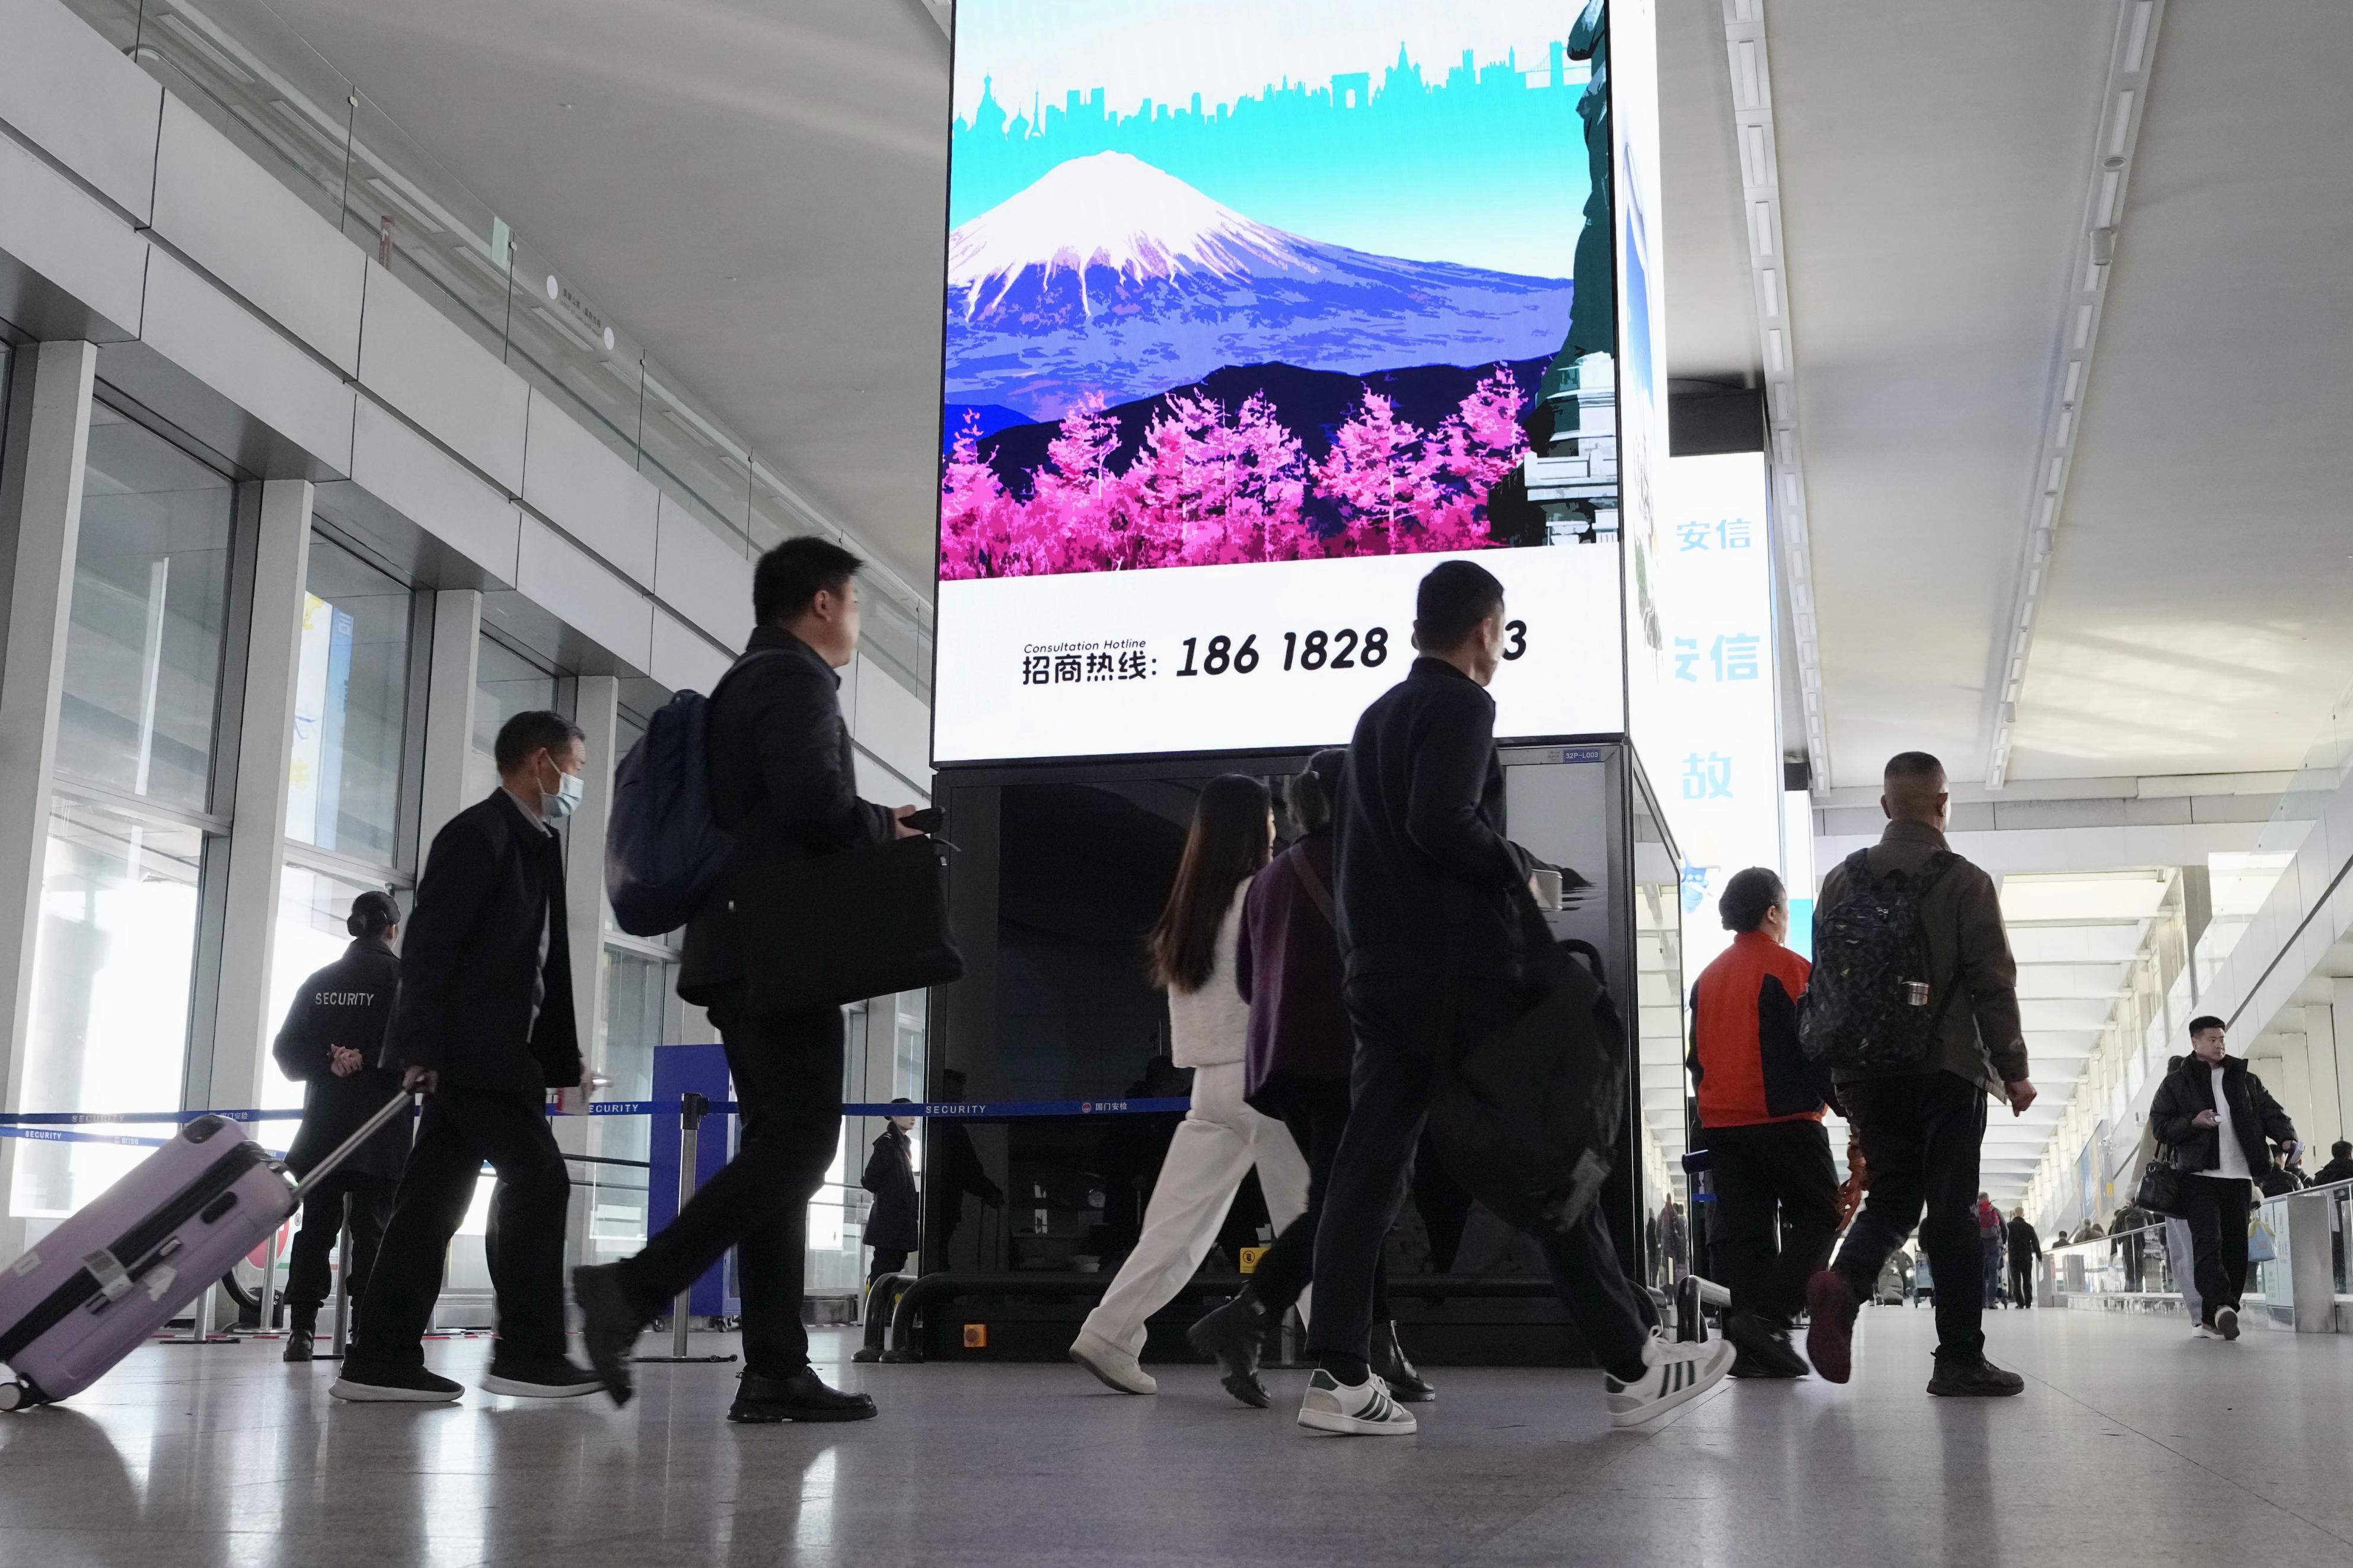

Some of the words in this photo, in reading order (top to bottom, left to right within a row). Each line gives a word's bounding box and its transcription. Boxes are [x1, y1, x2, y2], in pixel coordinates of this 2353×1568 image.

[1677, 518, 1751, 551] 安信
[1024, 641, 1099, 653] Consultation
[1104, 638, 1146, 649] Hotline
[1176, 634, 1260, 676] 186
[1284, 627, 1388, 671] 1828
[1682, 752, 1733, 800] 故
[315, 992, 374, 1006] SECURITY
[589, 1104, 639, 1113] ECURITY
[926, 1105, 986, 1114] SECURITY
[1095, 1102, 1127, 1111] 国门安检
[71, 1114, 125, 1123] SECURITY
[25, 1131, 62, 1140] SECURITY
